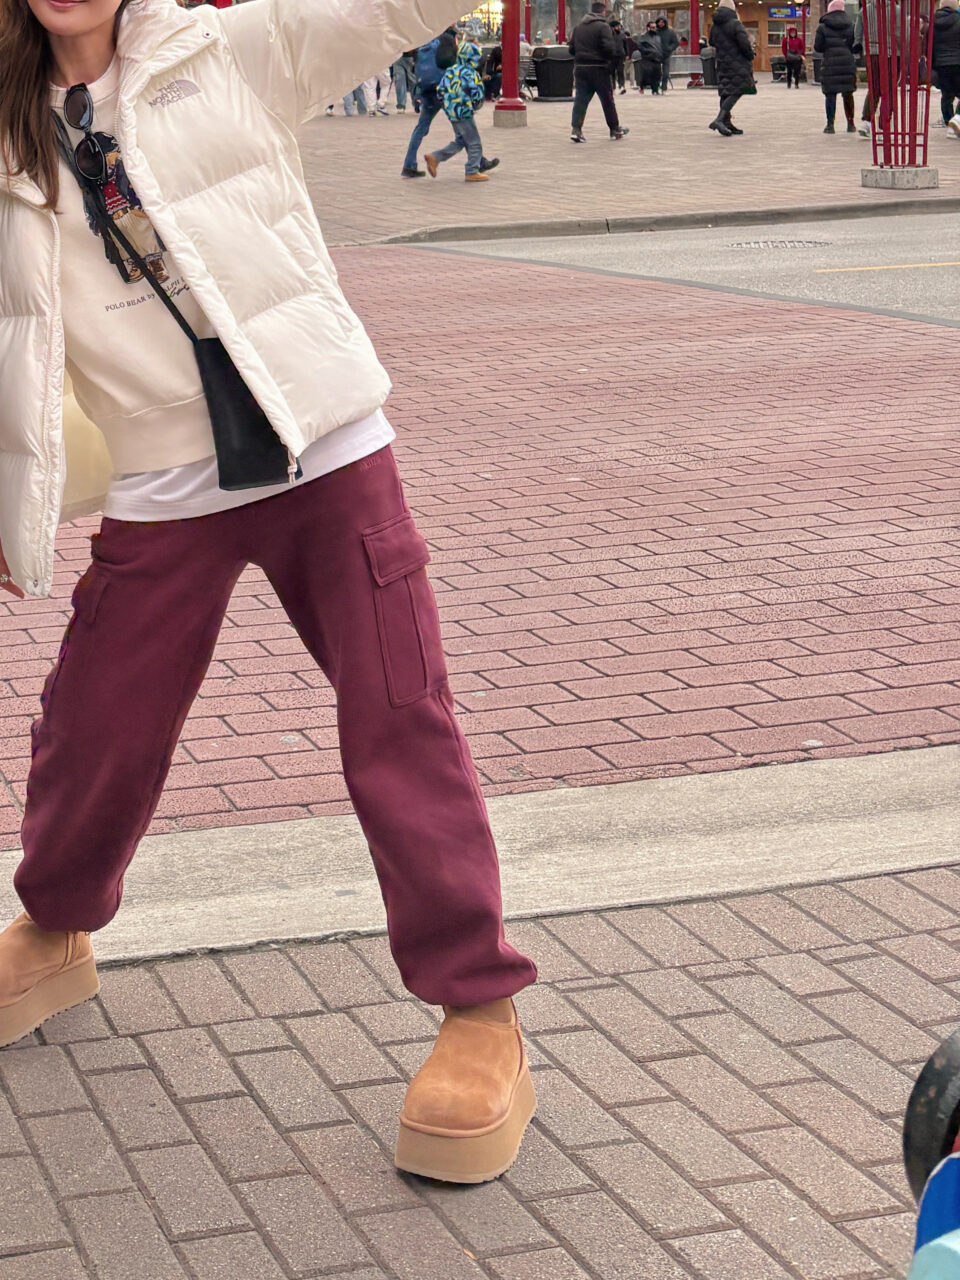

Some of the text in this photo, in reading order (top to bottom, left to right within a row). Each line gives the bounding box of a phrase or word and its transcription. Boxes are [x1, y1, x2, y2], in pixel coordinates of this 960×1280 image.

[157, 81, 175, 94] THE
[148, 85, 182, 108] NORTH
[160, 93, 185, 108] FACE
[105, 302, 125, 312] POLO
[126, 296, 147, 307] BEAR
